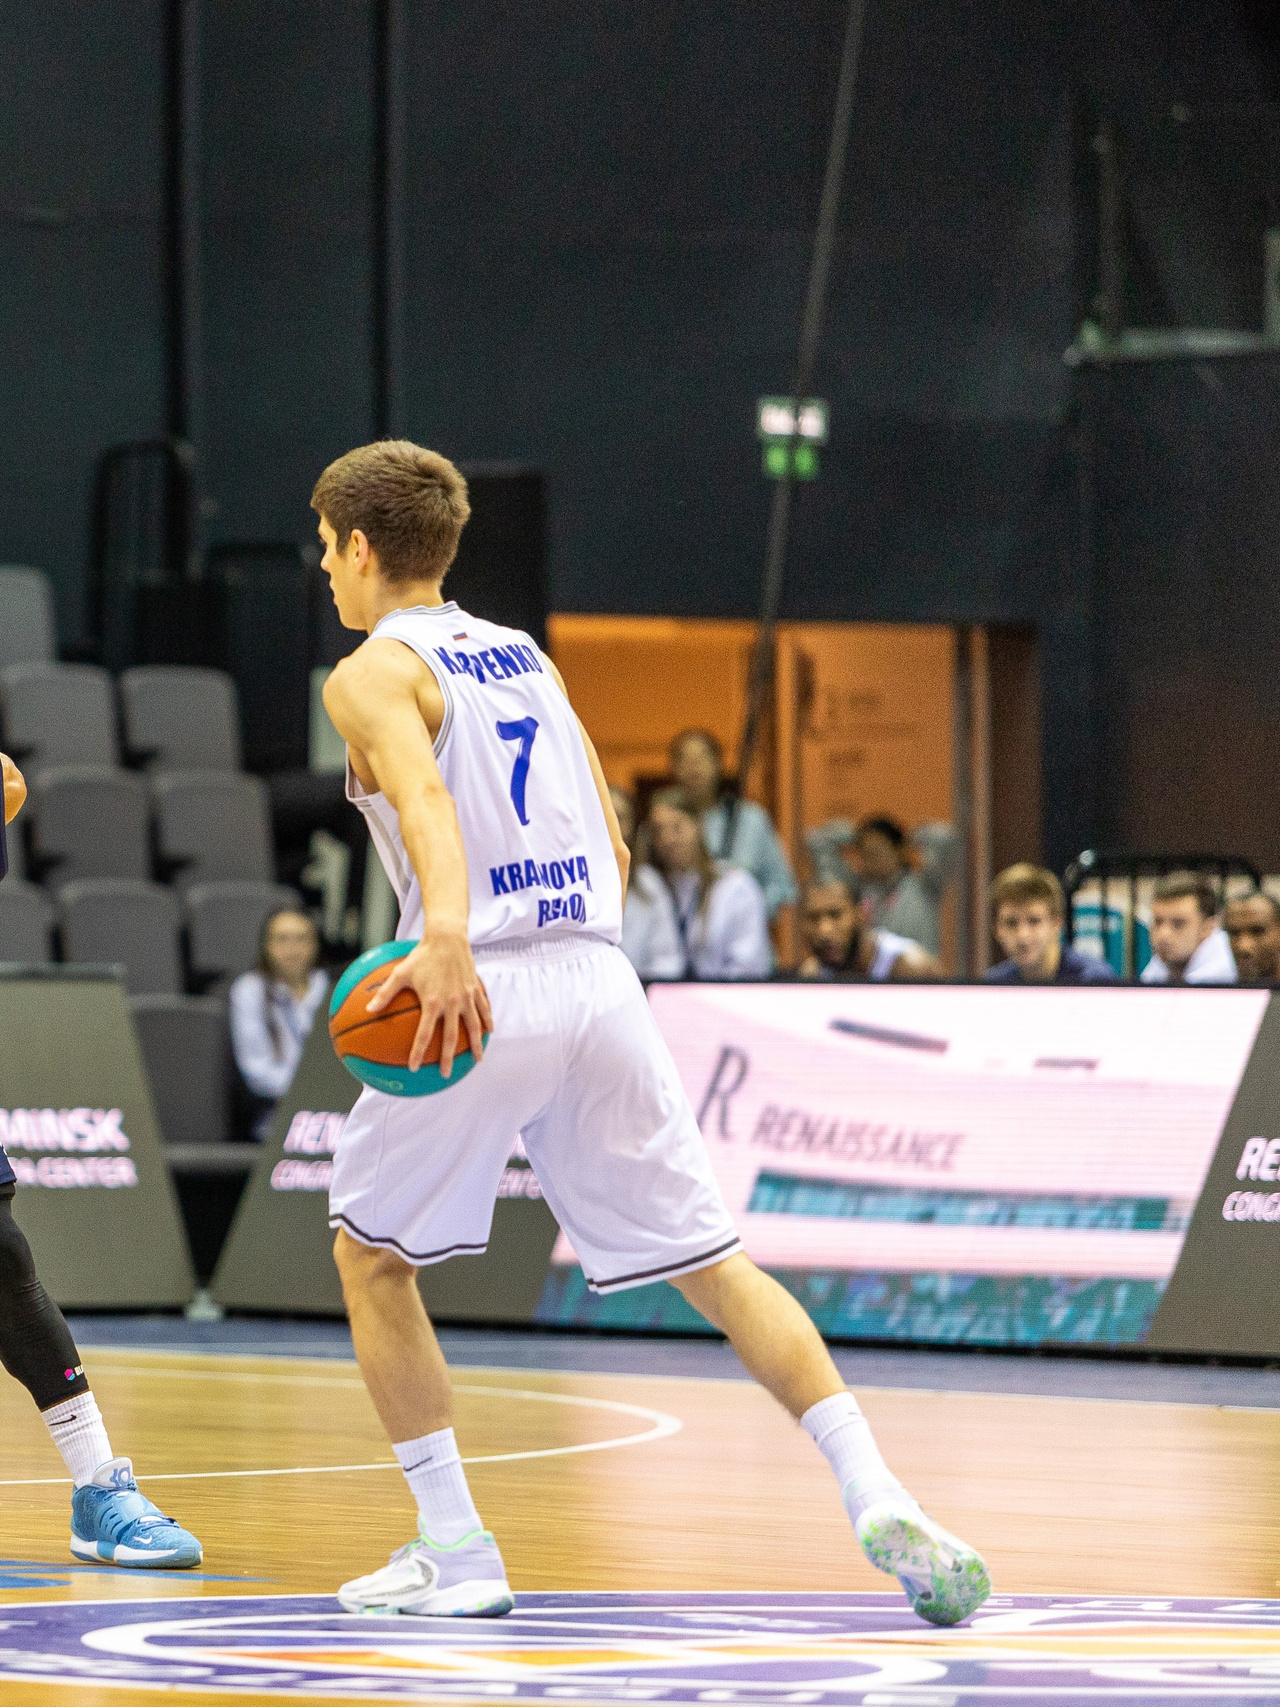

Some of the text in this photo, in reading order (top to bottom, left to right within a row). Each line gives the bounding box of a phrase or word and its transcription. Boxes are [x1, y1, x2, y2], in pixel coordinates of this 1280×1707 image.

[496, 716, 539, 827] 7
[697, 1044, 751, 1141] R
[751, 1103, 967, 1172] RENAISSANCE
